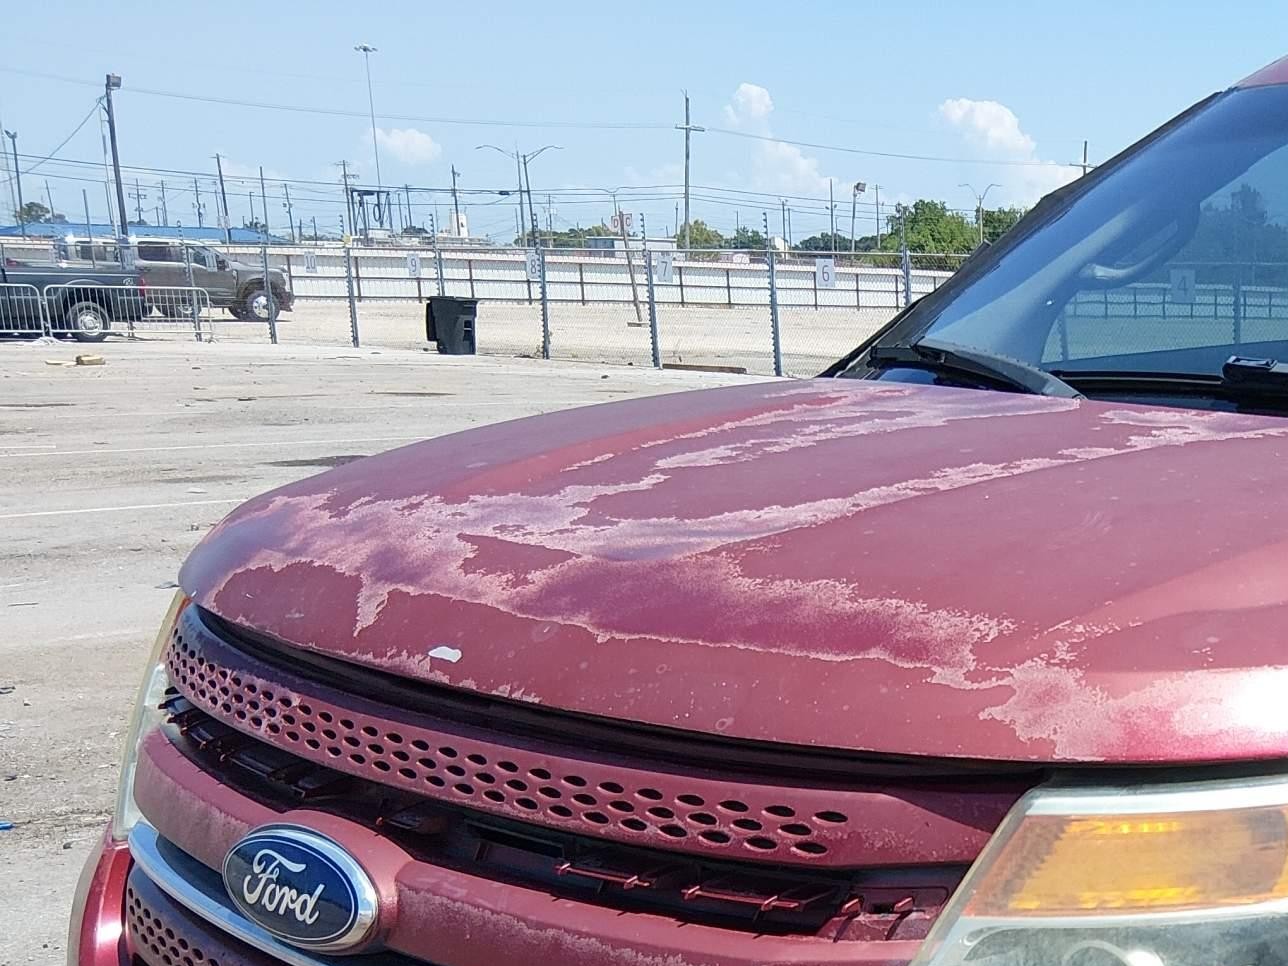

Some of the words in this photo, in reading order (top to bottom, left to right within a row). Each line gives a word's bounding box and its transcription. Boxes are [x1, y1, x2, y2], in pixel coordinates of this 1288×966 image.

[304, 255, 315, 269] 10
[410, 258, 417, 273] 9
[530, 259, 537, 274] 8
[660, 260, 668, 277] 7
[821, 264, 830, 282] 6
[1177, 275, 1189, 297] 4
[243, 849, 326, 925] Ford
